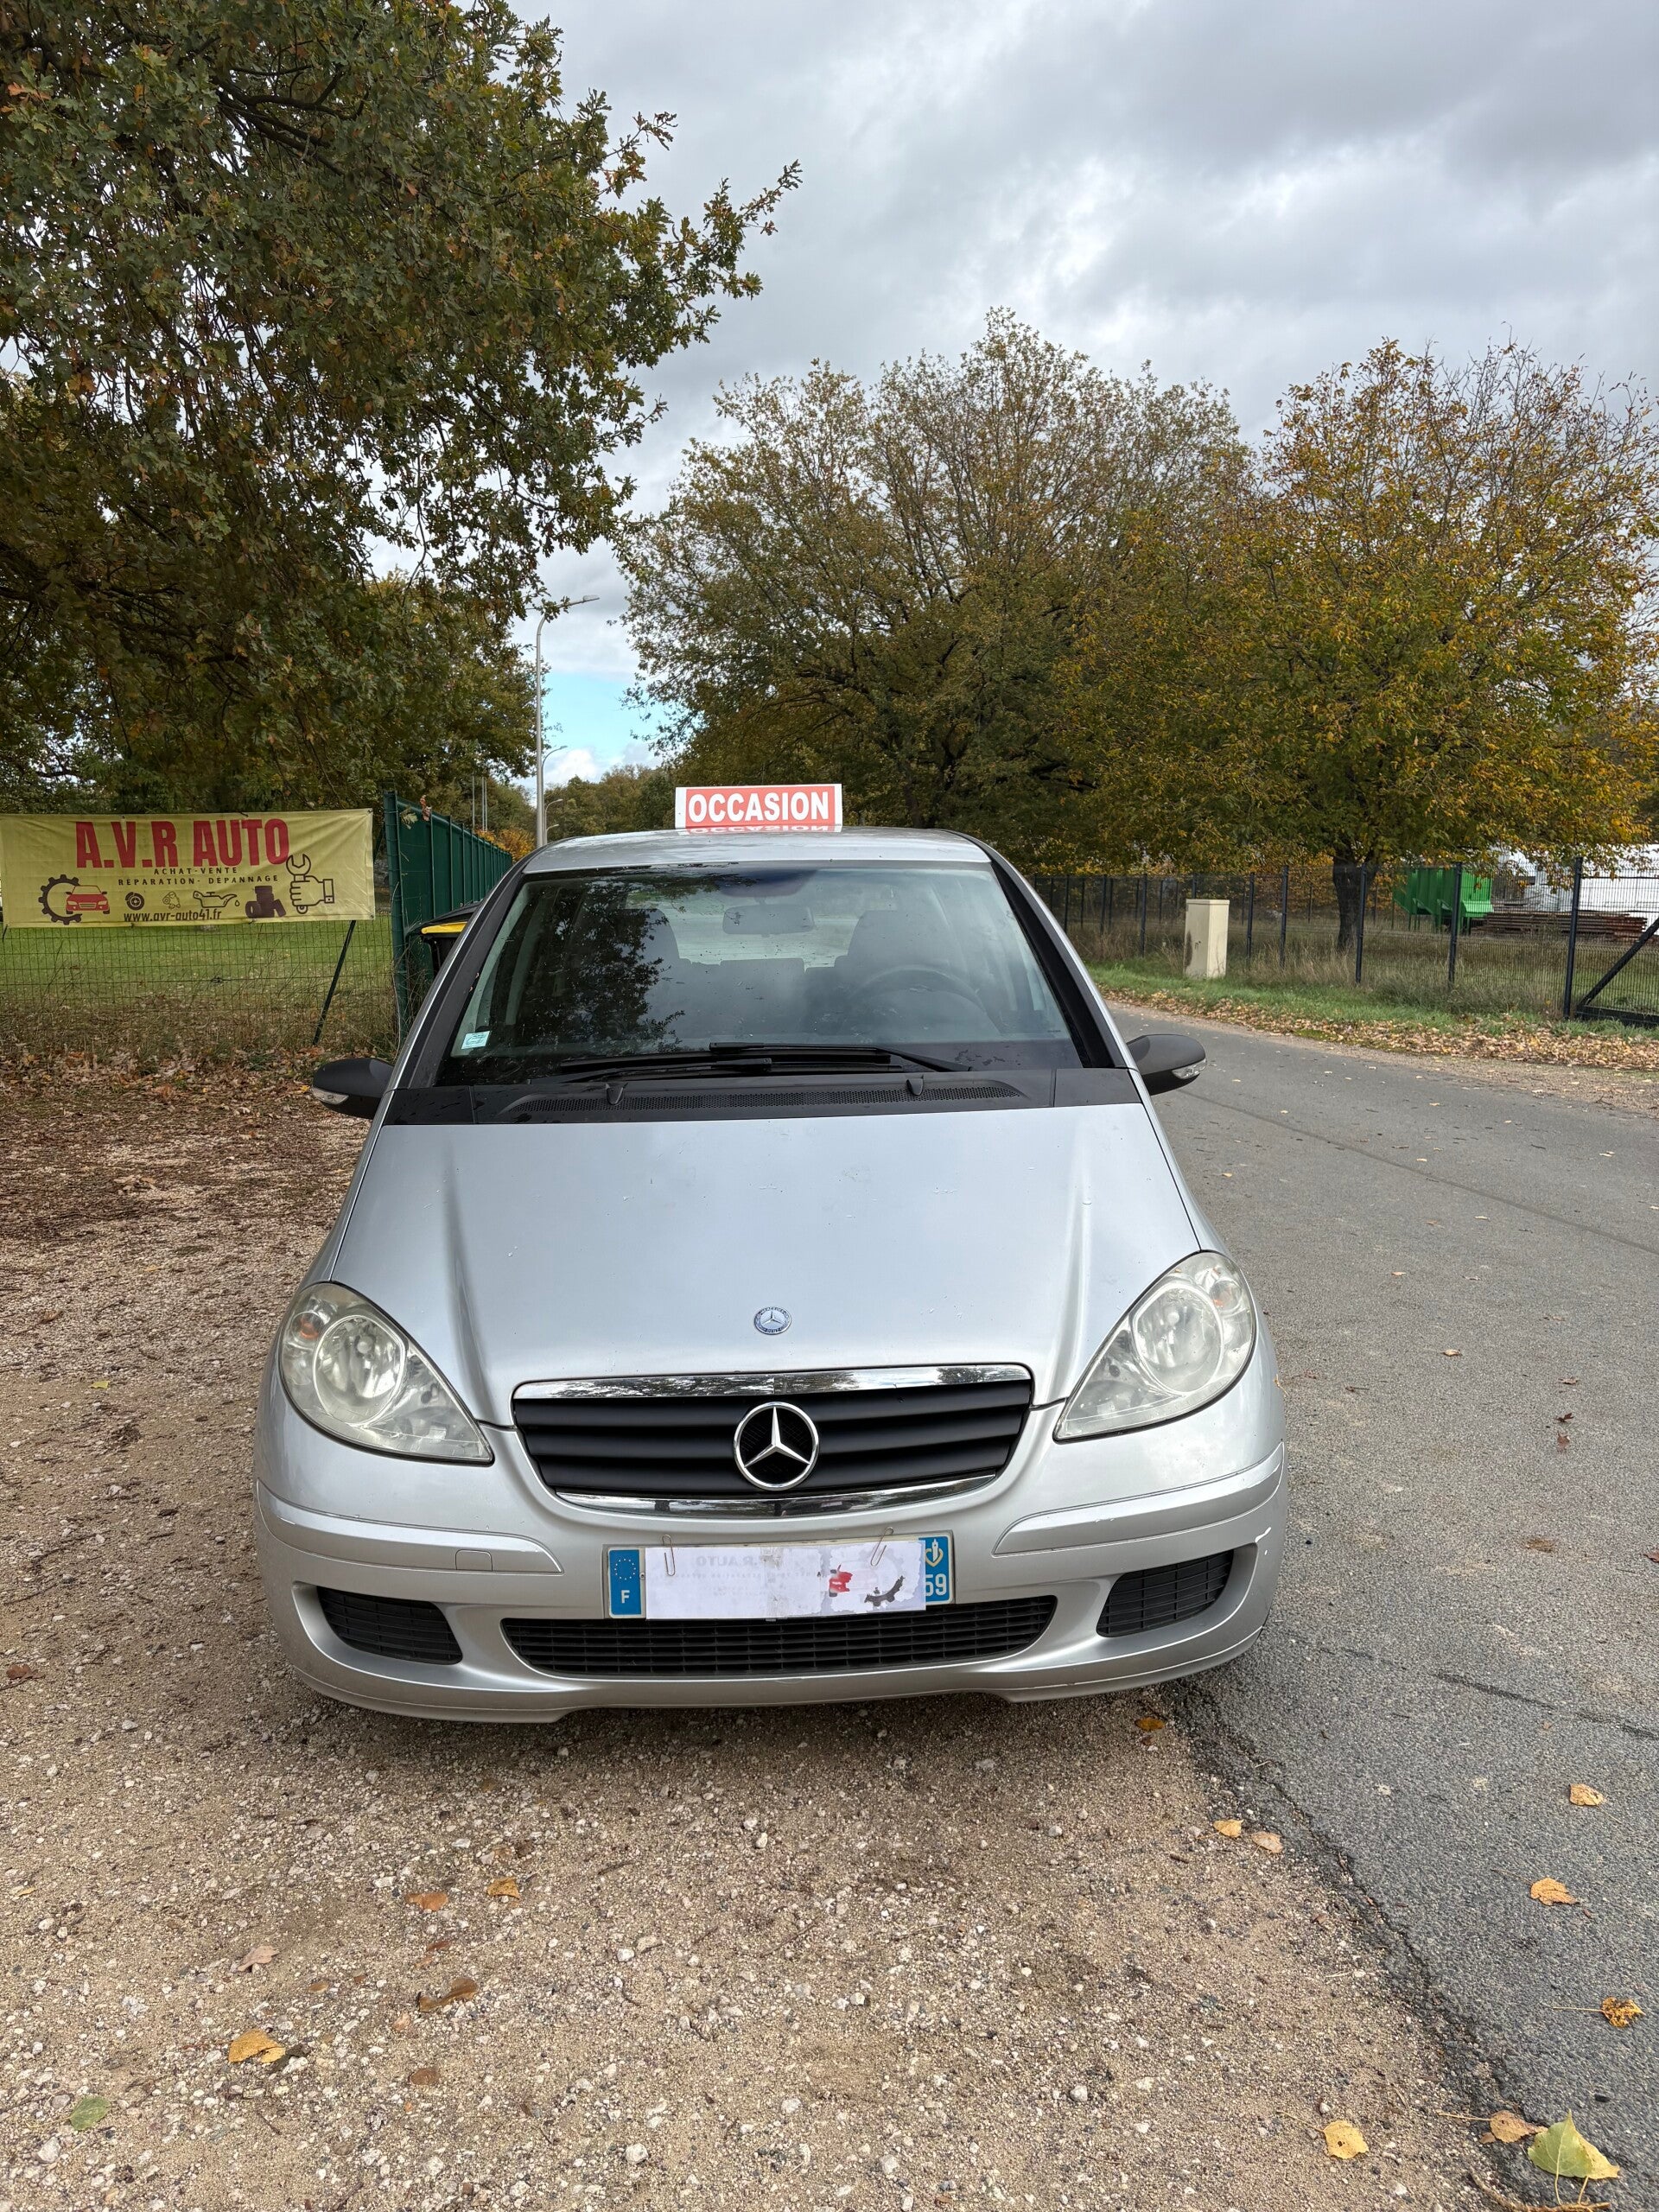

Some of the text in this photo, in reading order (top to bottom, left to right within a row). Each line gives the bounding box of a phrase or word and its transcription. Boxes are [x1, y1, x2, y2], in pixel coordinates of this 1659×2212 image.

[688, 791, 829, 823] OCCASION
[75, 818, 289, 868] A.V.R AUTO
[154, 867, 238, 875] ACHAT-VENTE
[124, 908, 222, 922] www.avr-auto41.fr
[925, 1573, 947, 1597] 59
[621, 1590, 630, 1604] F
